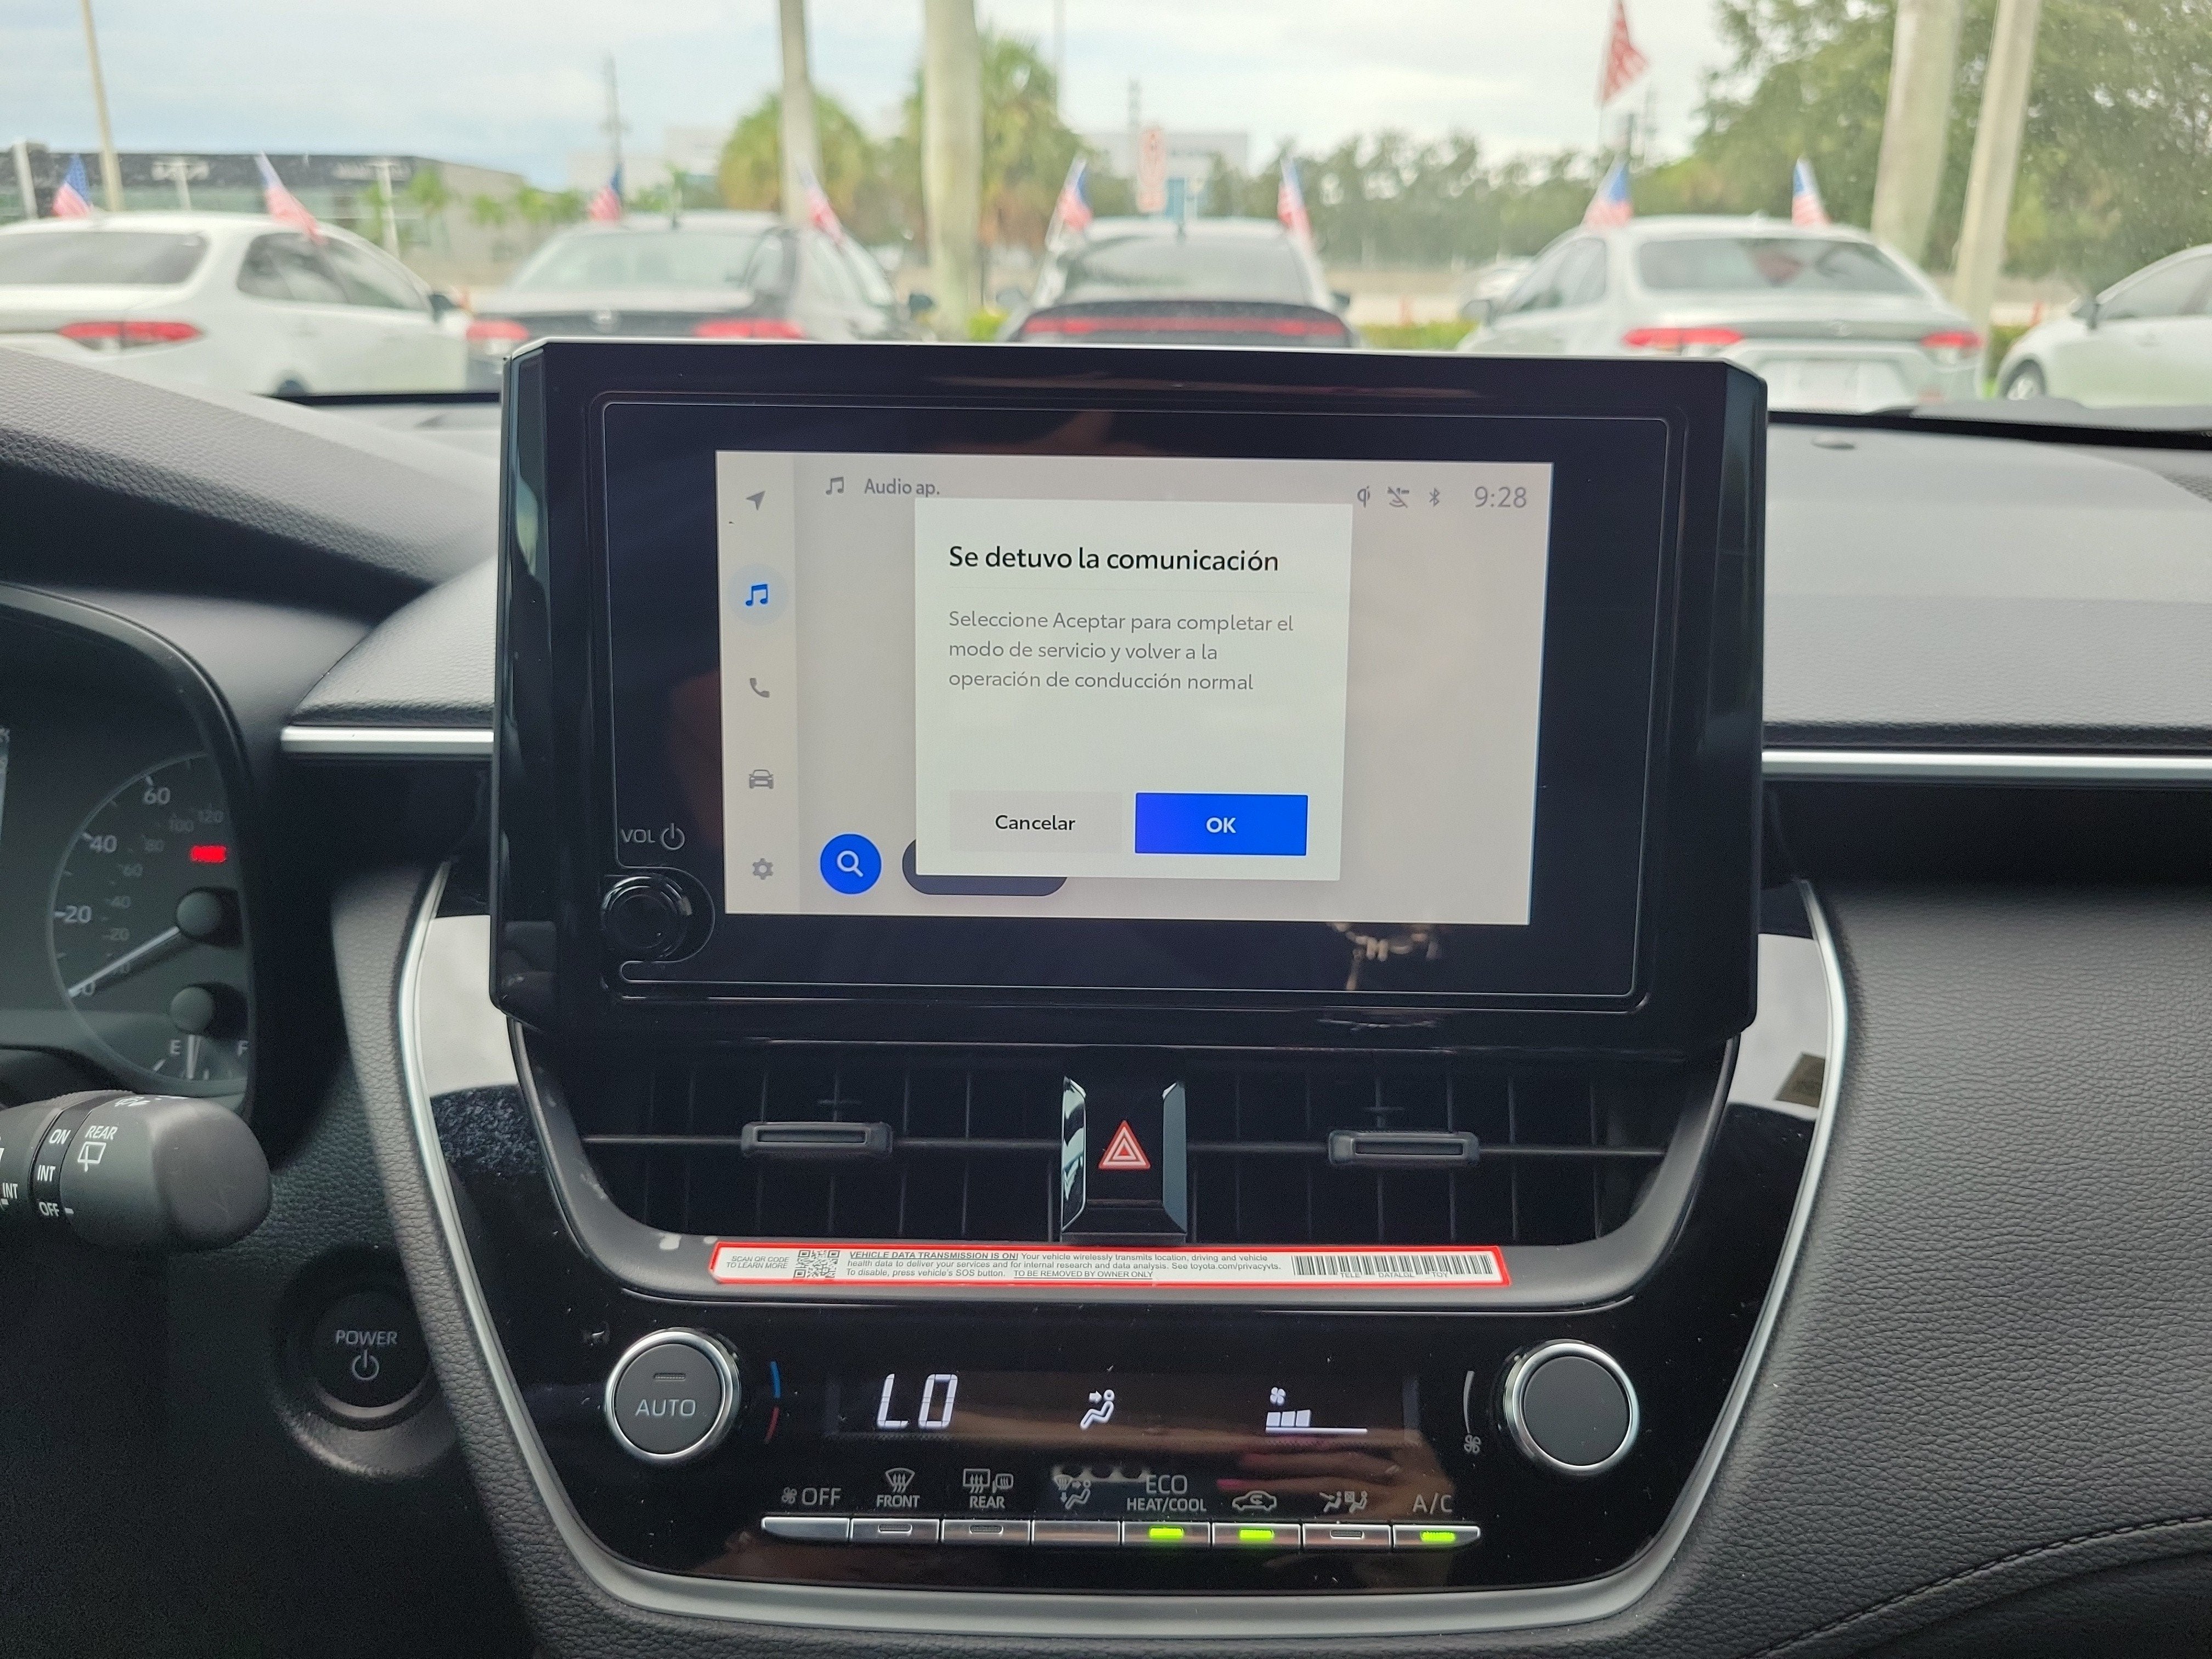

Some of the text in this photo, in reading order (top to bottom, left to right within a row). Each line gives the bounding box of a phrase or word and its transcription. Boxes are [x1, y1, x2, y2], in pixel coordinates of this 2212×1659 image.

[864, 478, 940, 498] Audio ap.
[1474, 486, 1527, 508] 9:28
[950, 545, 1278, 571] Se detuvo la comunicación
[949, 611, 1294, 635] Seleccione Aceptar para completar el
[949, 640, 1217, 663] modo de servicio y volver a la
[949, 671, 1254, 690] operación de conducción normal
[144, 787, 171, 805] 60
[995, 814, 1076, 831] Cancelar
[1206, 817, 1237, 834] OK
[90, 834, 117, 853] 40
[621, 828, 656, 843] VOL
[64, 905, 92, 924] 20
[170, 1040, 181, 1055] E
[238, 1040, 248, 1056] F
[49, 1128, 71, 1144] ON
[85, 1125, 118, 1140] REAR
[37, 1165, 56, 1182] INT
[2, 1182, 18, 1199] INT
[38, 1201, 60, 1217] OFF
[1073, 1253, 1112, 1261] wirelessly
[858, 1268, 890, 1277] disable,
[1133, 1262, 1169, 1271] analysis.
[1190, 1262, 1282, 1271] toyota.com/privacyvts.
[336, 1330, 398, 1345] POWER
[635, 1398, 696, 1417] AUTO
[877, 1373, 958, 1428] LO
[1146, 1475, 1188, 1495] ECO
[802, 1487, 841, 1505] OFF
[877, 1494, 920, 1508] FRONT
[969, 1496, 1005, 1509] REAR
[1413, 1494, 1452, 1514] A/C
[1126, 1498, 1206, 1513] HEAT/COOL
